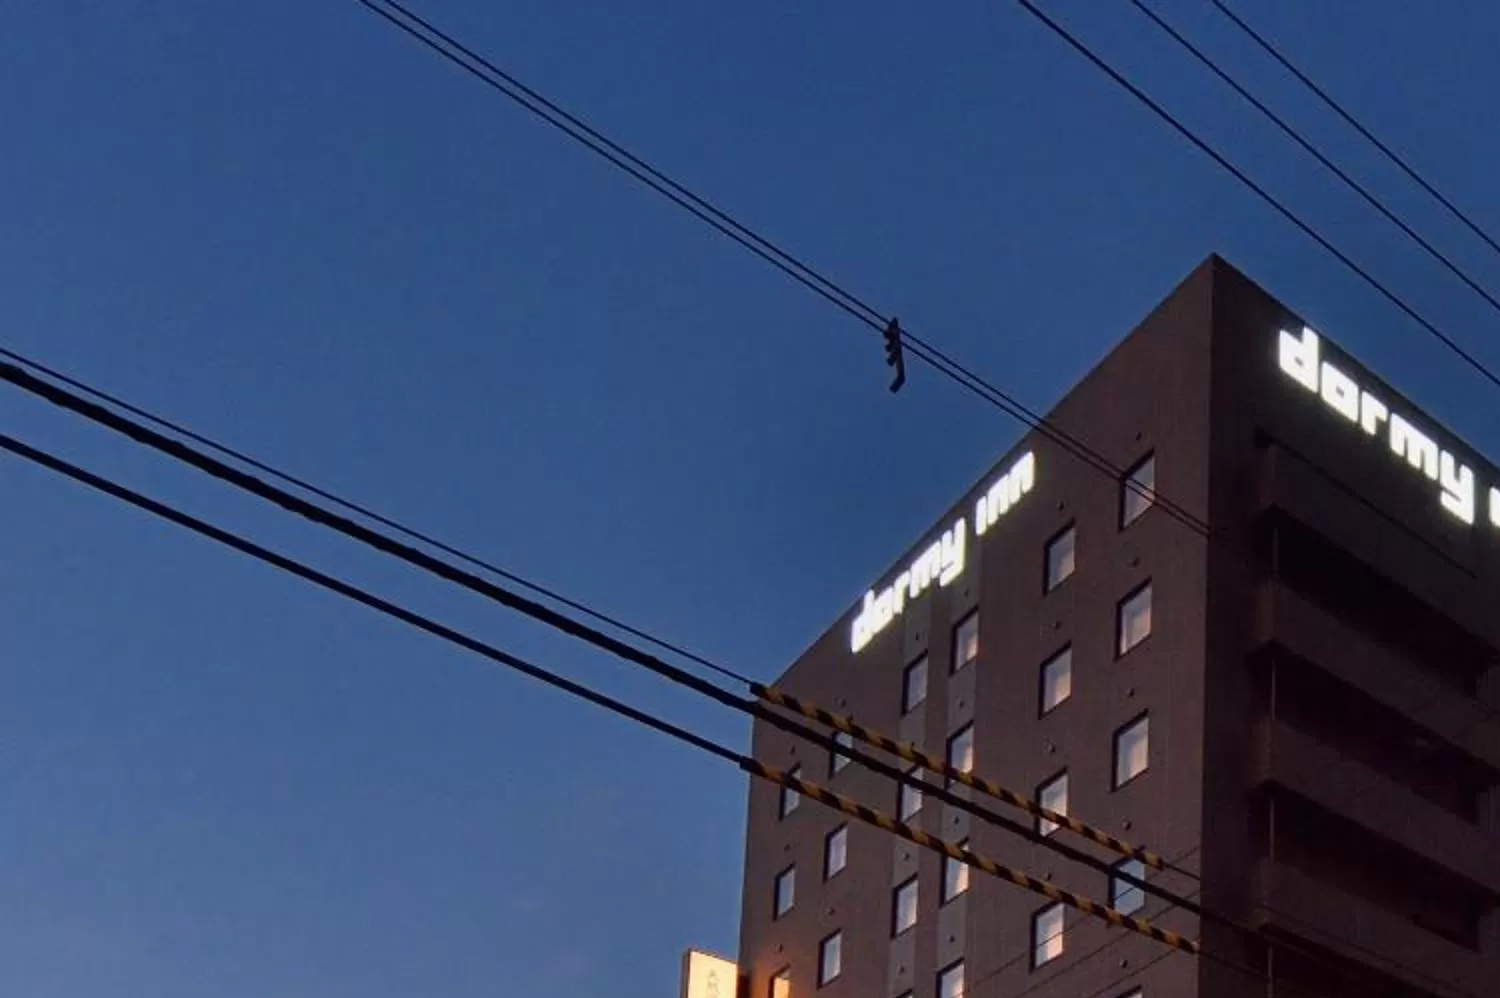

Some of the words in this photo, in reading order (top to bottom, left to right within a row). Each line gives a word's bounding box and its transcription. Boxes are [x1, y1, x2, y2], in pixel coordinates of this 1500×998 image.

[1277, 326, 1475, 526] dormy
[849, 516, 966, 654] dormy
[975, 450, 1036, 536] inn
